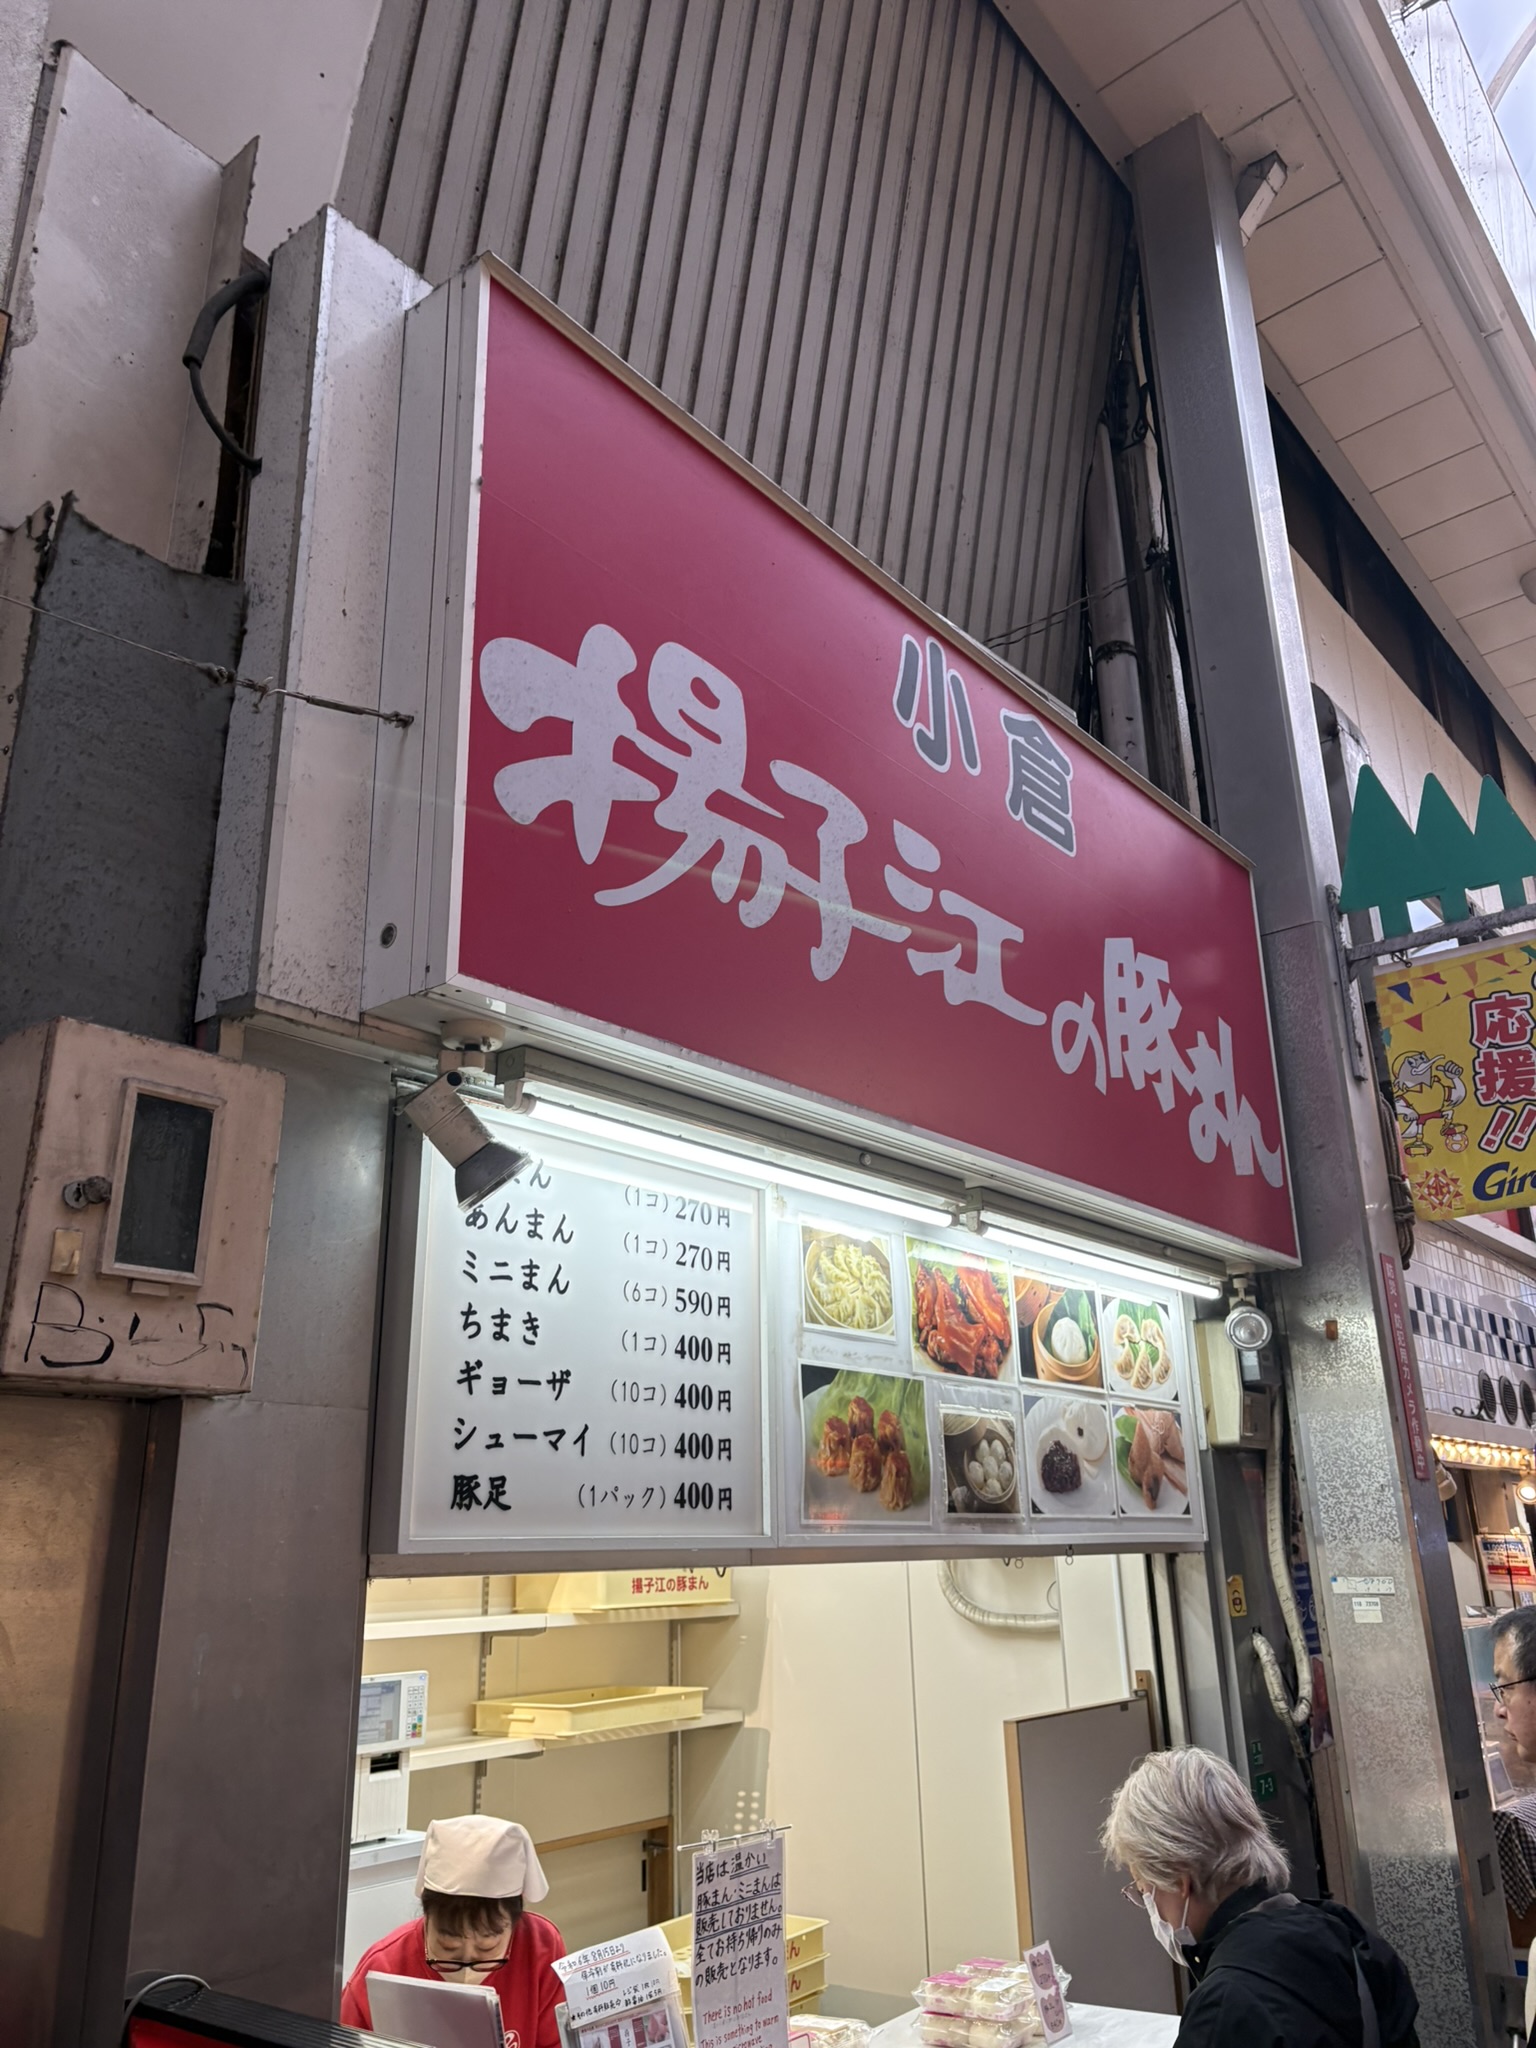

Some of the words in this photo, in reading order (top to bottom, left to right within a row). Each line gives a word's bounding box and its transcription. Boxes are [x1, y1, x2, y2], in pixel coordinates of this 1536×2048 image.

[892, 632, 1077, 858] 小倉
[465, 1202, 574, 1244] あんまん
[462, 1249, 570, 1295] ミニまん
[459, 1301, 541, 1346] ちまき
[456, 1358, 572, 1402] ギョーザ
[453, 1417, 590, 1458] シューマイ
[449, 1473, 512, 1512] 豚足
[631, 1576, 709, 1594] 揚子江の豚まん
[696, 1852, 766, 1887] 当店は温かい
[695, 1898, 783, 1937] 販売しておりません。
[695, 1923, 783, 1966] 全てお持ち帰りのみ
[695, 1946, 779, 1988] の販売となります。
[702, 2008, 723, 2025] There
[724, 2005, 732, 2018] is
[733, 2003, 742, 2015] no
[743, 1995, 755, 2011] hot
[757, 1987, 773, 2006] food
[715, 2036, 722, 2046] is
[724, 2023, 754, 2043] something
[755, 2018, 762, 2031] to
[762, 2014, 779, 2028] warm
